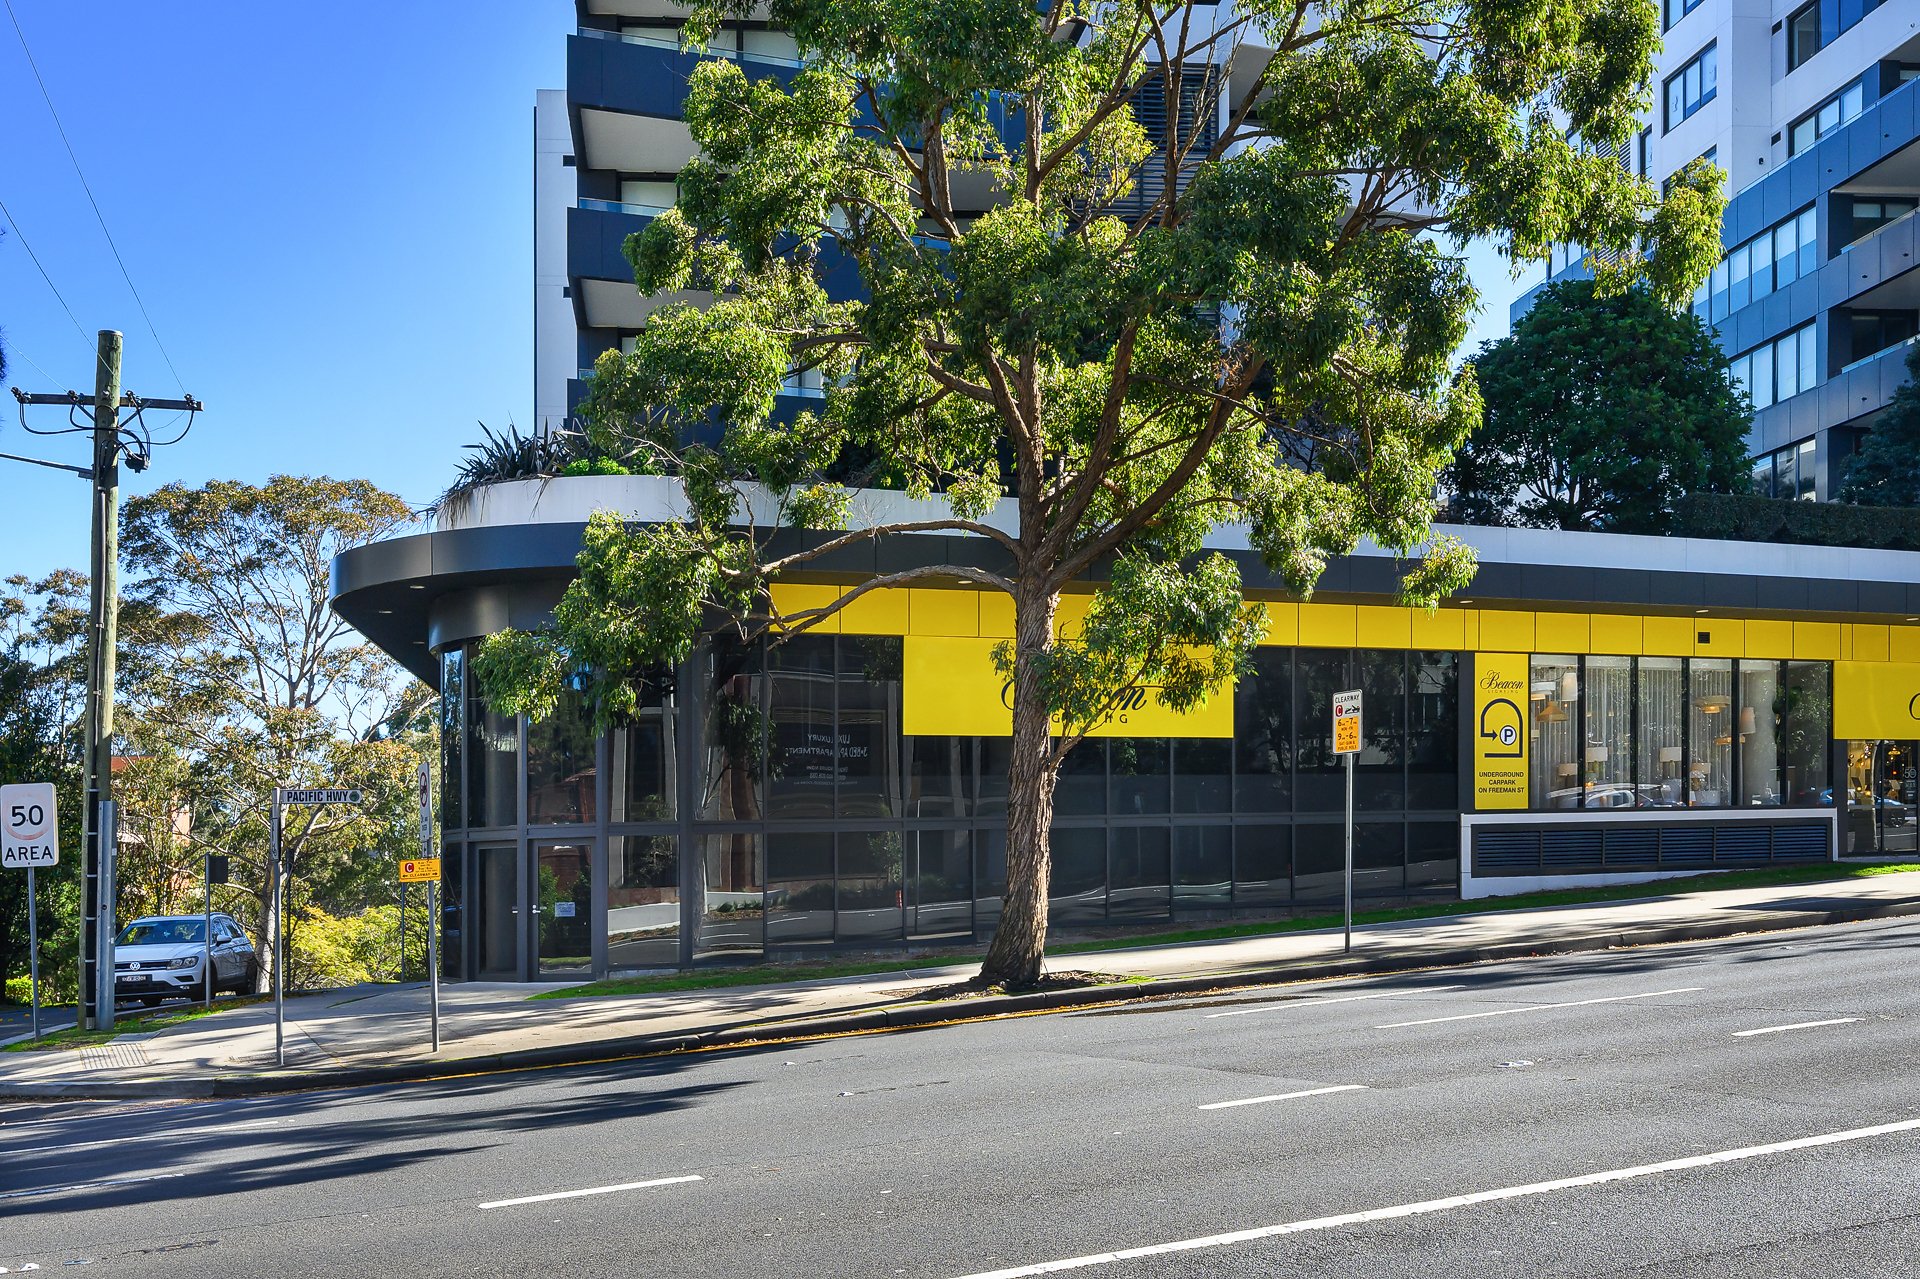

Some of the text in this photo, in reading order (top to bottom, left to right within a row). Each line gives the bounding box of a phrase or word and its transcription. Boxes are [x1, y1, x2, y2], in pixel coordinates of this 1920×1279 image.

[1480, 669, 1524, 691] Beacon
[1335, 694, 1360, 704] CLEARWAY
[1504, 728, 1513, 742] P
[287, 791, 349, 802] PACIFIC HWY
[11, 804, 44, 827] 50
[4, 845, 54, 861] AREA
